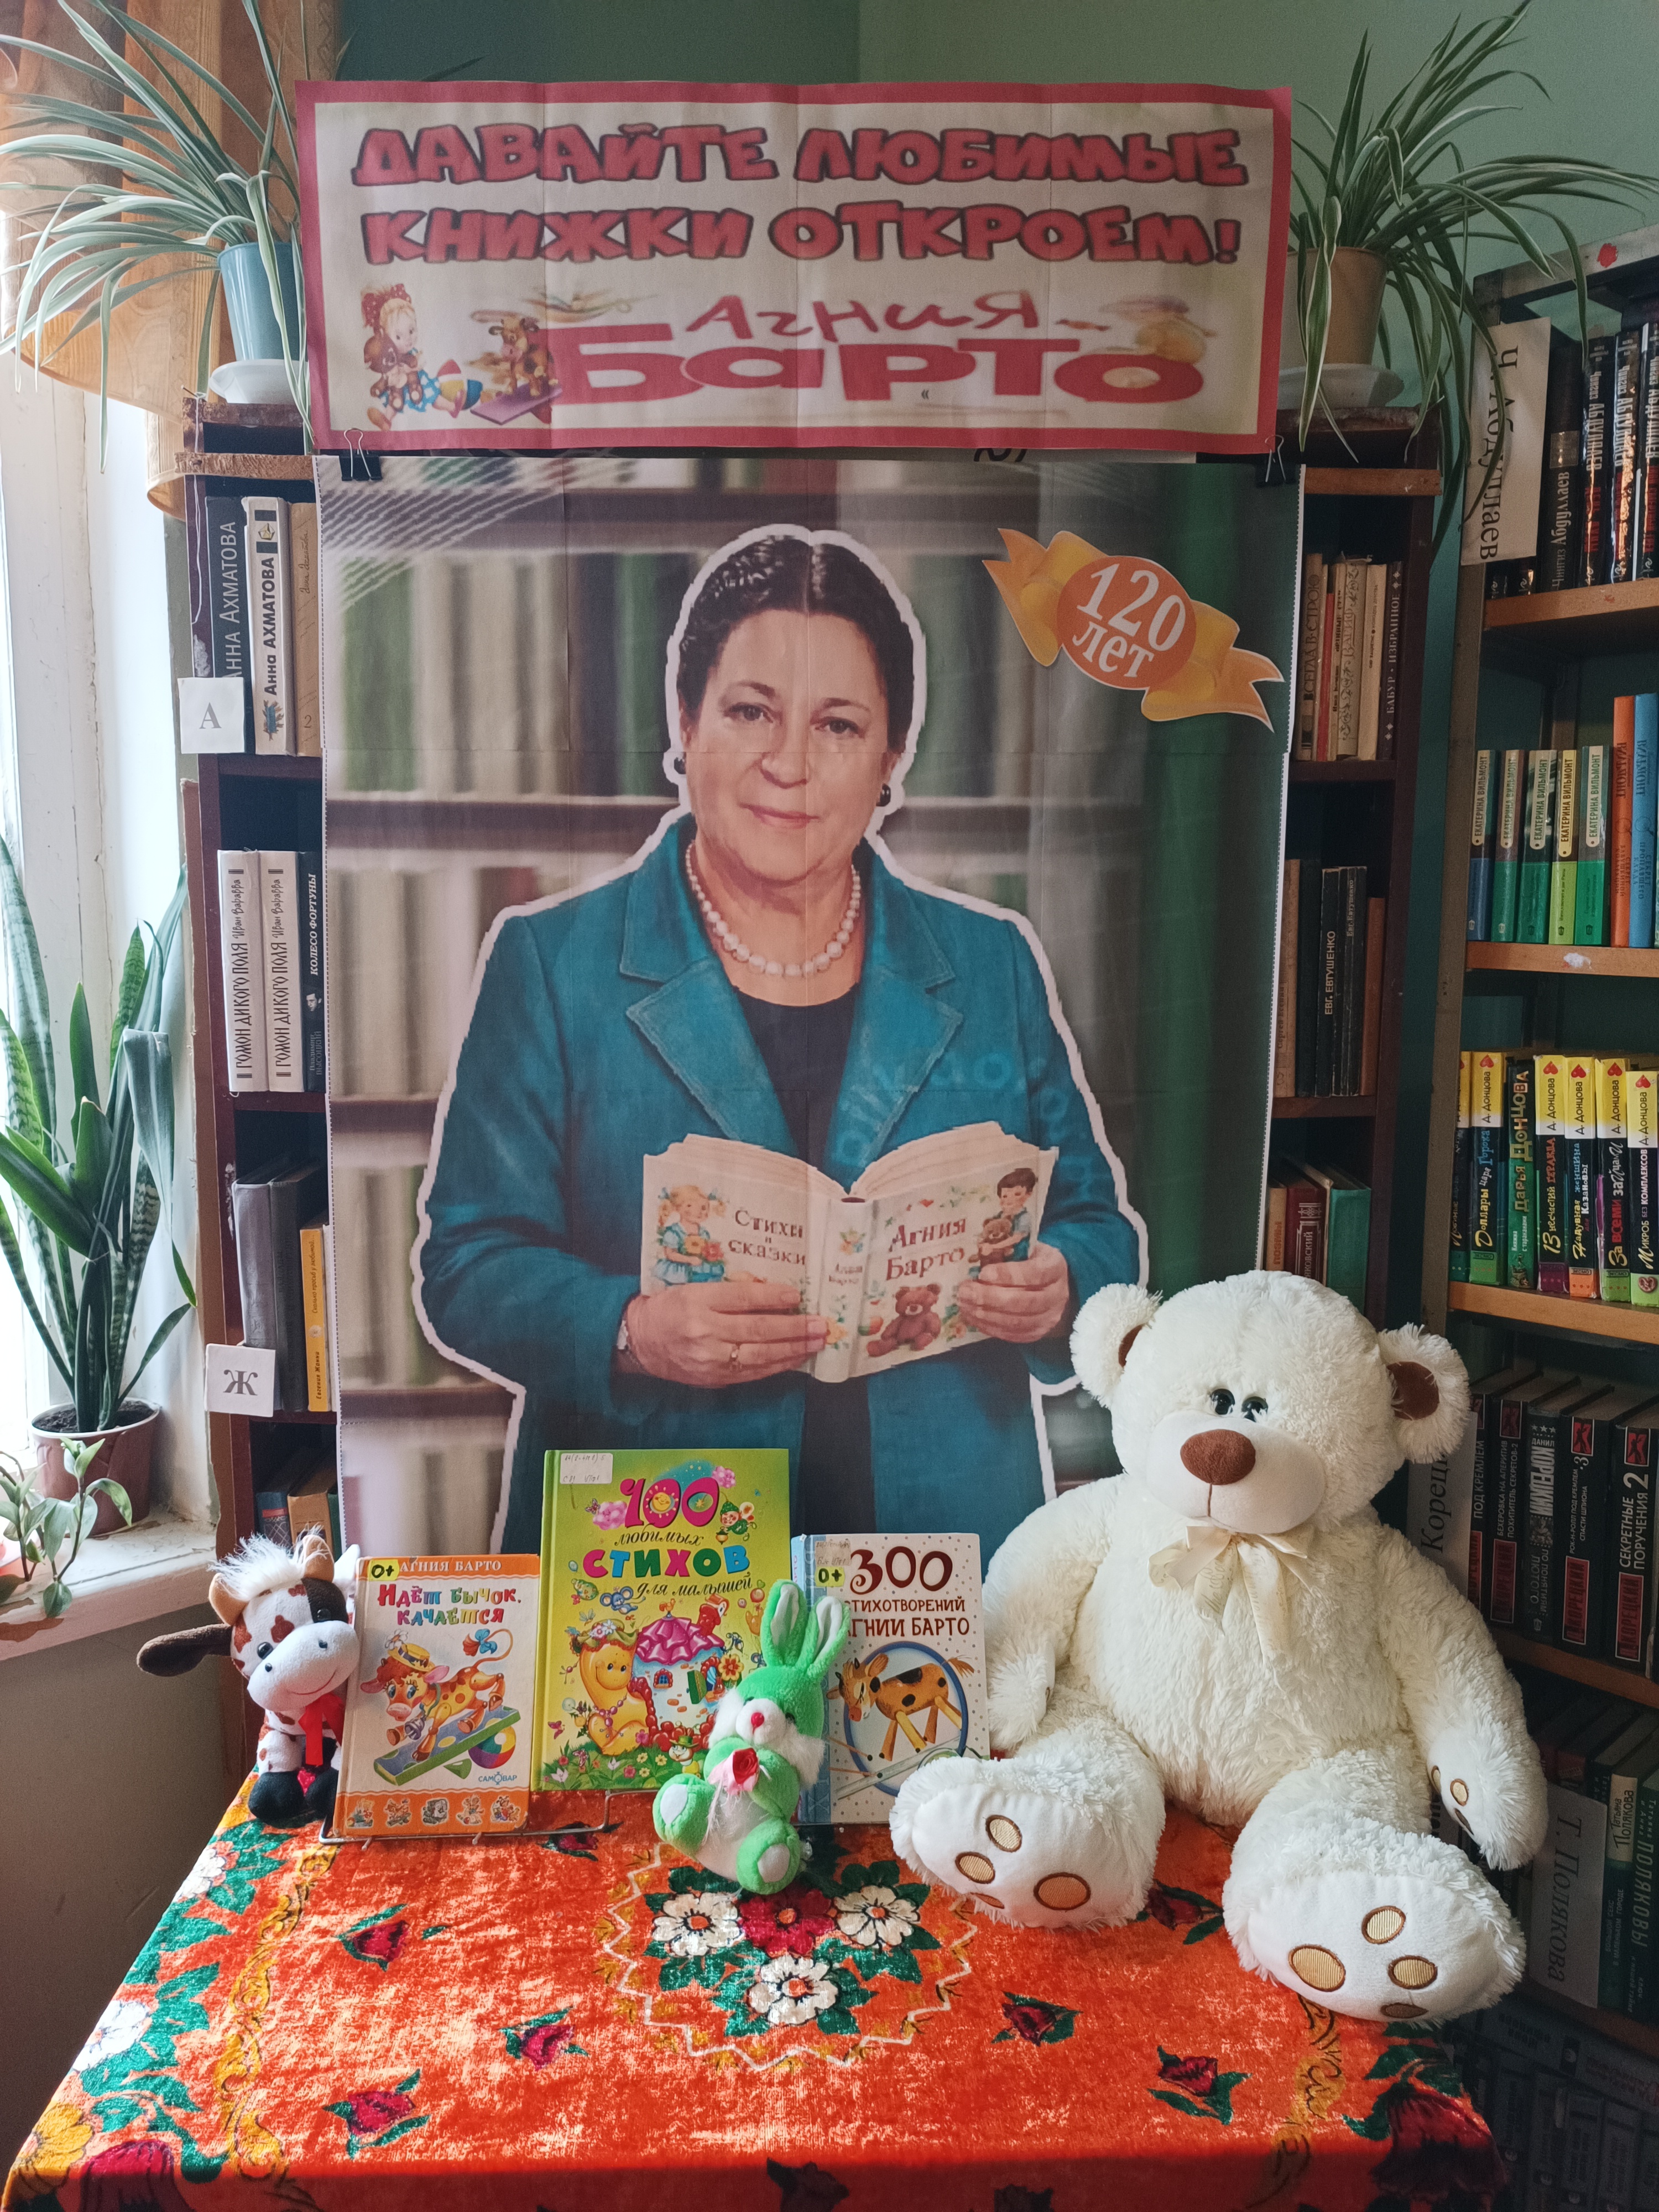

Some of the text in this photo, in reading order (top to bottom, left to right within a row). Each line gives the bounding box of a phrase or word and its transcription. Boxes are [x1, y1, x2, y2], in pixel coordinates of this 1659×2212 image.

[352, 122, 1249, 189] ДАВАЙТЕ ЛЮБИМЫЕ
[361, 199, 1241, 267] КНИЖКИ ОТКРОЕМ!
[685, 288, 1041, 343] Агния
[1586, 403, 1604, 471] АБДУЛЛАЕВ
[1551, 471, 1571, 545] Абдуллаев
[220, 521, 240, 624] АХМАТОВА
[261, 557, 277, 696] Анна АХМАТОВА
[1077, 562, 1187, 652] 120
[1072, 620, 1155, 678] лет
[1386, 594, 1400, 713] БАБУР ИЗБРАННОЕ
[199, 702, 222, 729] А
[304, 714, 312, 728] 2
[1474, 756, 1488, 836] ЕКАТЕРИНА ВИЛЬМОНТ
[1503, 758, 1516, 839] ЕКАТЕРИНА ВИЛЬМОНТ
[1534, 759, 1547, 840] ЕКАТЕРИНА ВИЛЬМОНТ
[1561, 759, 1573, 842] ЕКАТЕРИНА ВИЛЬМОНТ
[1589, 754, 1600, 837] ЕКАТЕРИНА ВИЛЬМОНТ
[309, 874, 319, 976] КОЛЕСО ФОРТУНЫ
[230, 943, 249, 974] ПОЛЯ
[270, 942, 288, 974] ПОЛЯ
[1325, 931, 1335, 1015] ЕВГ. ЕВТУШЕНКО
[232, 977, 252, 1026] ДИКОГО
[272, 977, 291, 1025] ДИКОГО
[234, 1028, 252, 1068] ГОМОН
[274, 1027, 291, 1067] ГОМОН
[1481, 1071, 1491, 1123] Д. Донцова
[1547, 1077, 1557, 1131] Д. Донцова
[1574, 1081, 1584, 1135] Д. Донцова
[1611, 1079, 1621, 1135] Д. Донцова
[1639, 1091, 1649, 1145] Д. Донцова
[734, 1209, 804, 1240] Стихи
[889, 1217, 967, 1253] Агния
[1543, 1232, 1561, 1254] 13
[886, 1246, 964, 1281] Барто
[1609, 1245, 1627, 1266] За
[223, 1368, 258, 1396] Ж
[1531, 1437, 1556, 1447] ДАНИЛ
[619, 1478, 719, 1528] 100
[1474, 1440, 1485, 1519] ПОД КРЕМЛЕМ
[1497, 1440, 1508, 1536] БЕХЕРОВКА НА АПЕРИТИВ
[1507, 1443, 1519, 1538] ПОХИТИТЕЛЬ СЕКРЕТОВ-2
[1529, 1445, 1556, 1516] КОРЕЦКИЙ
[1624, 1472, 1649, 1494] 2
[614, 1528, 704, 1547] любимых
[1619, 1496, 1634, 1569] СЕКРЕТНЫЕ
[1634, 1492, 1648, 1570] ПОРУЧЕНИЯ
[371, 1564, 395, 1579] 0+
[400, 1559, 502, 1572] АГНИЯ БАРТО
[582, 1544, 750, 1579] СТИХОВ
[633, 1569, 753, 1599] для малышей
[818, 1568, 843, 1583] 0+
[850, 1546, 953, 1595] 300
[847, 1616, 970, 1637] ГНИИ БАРТО
[1548, 1849, 1580, 1981] Полякова
[1630, 1840, 1654, 1948] ПОЛЯКОВЫ
